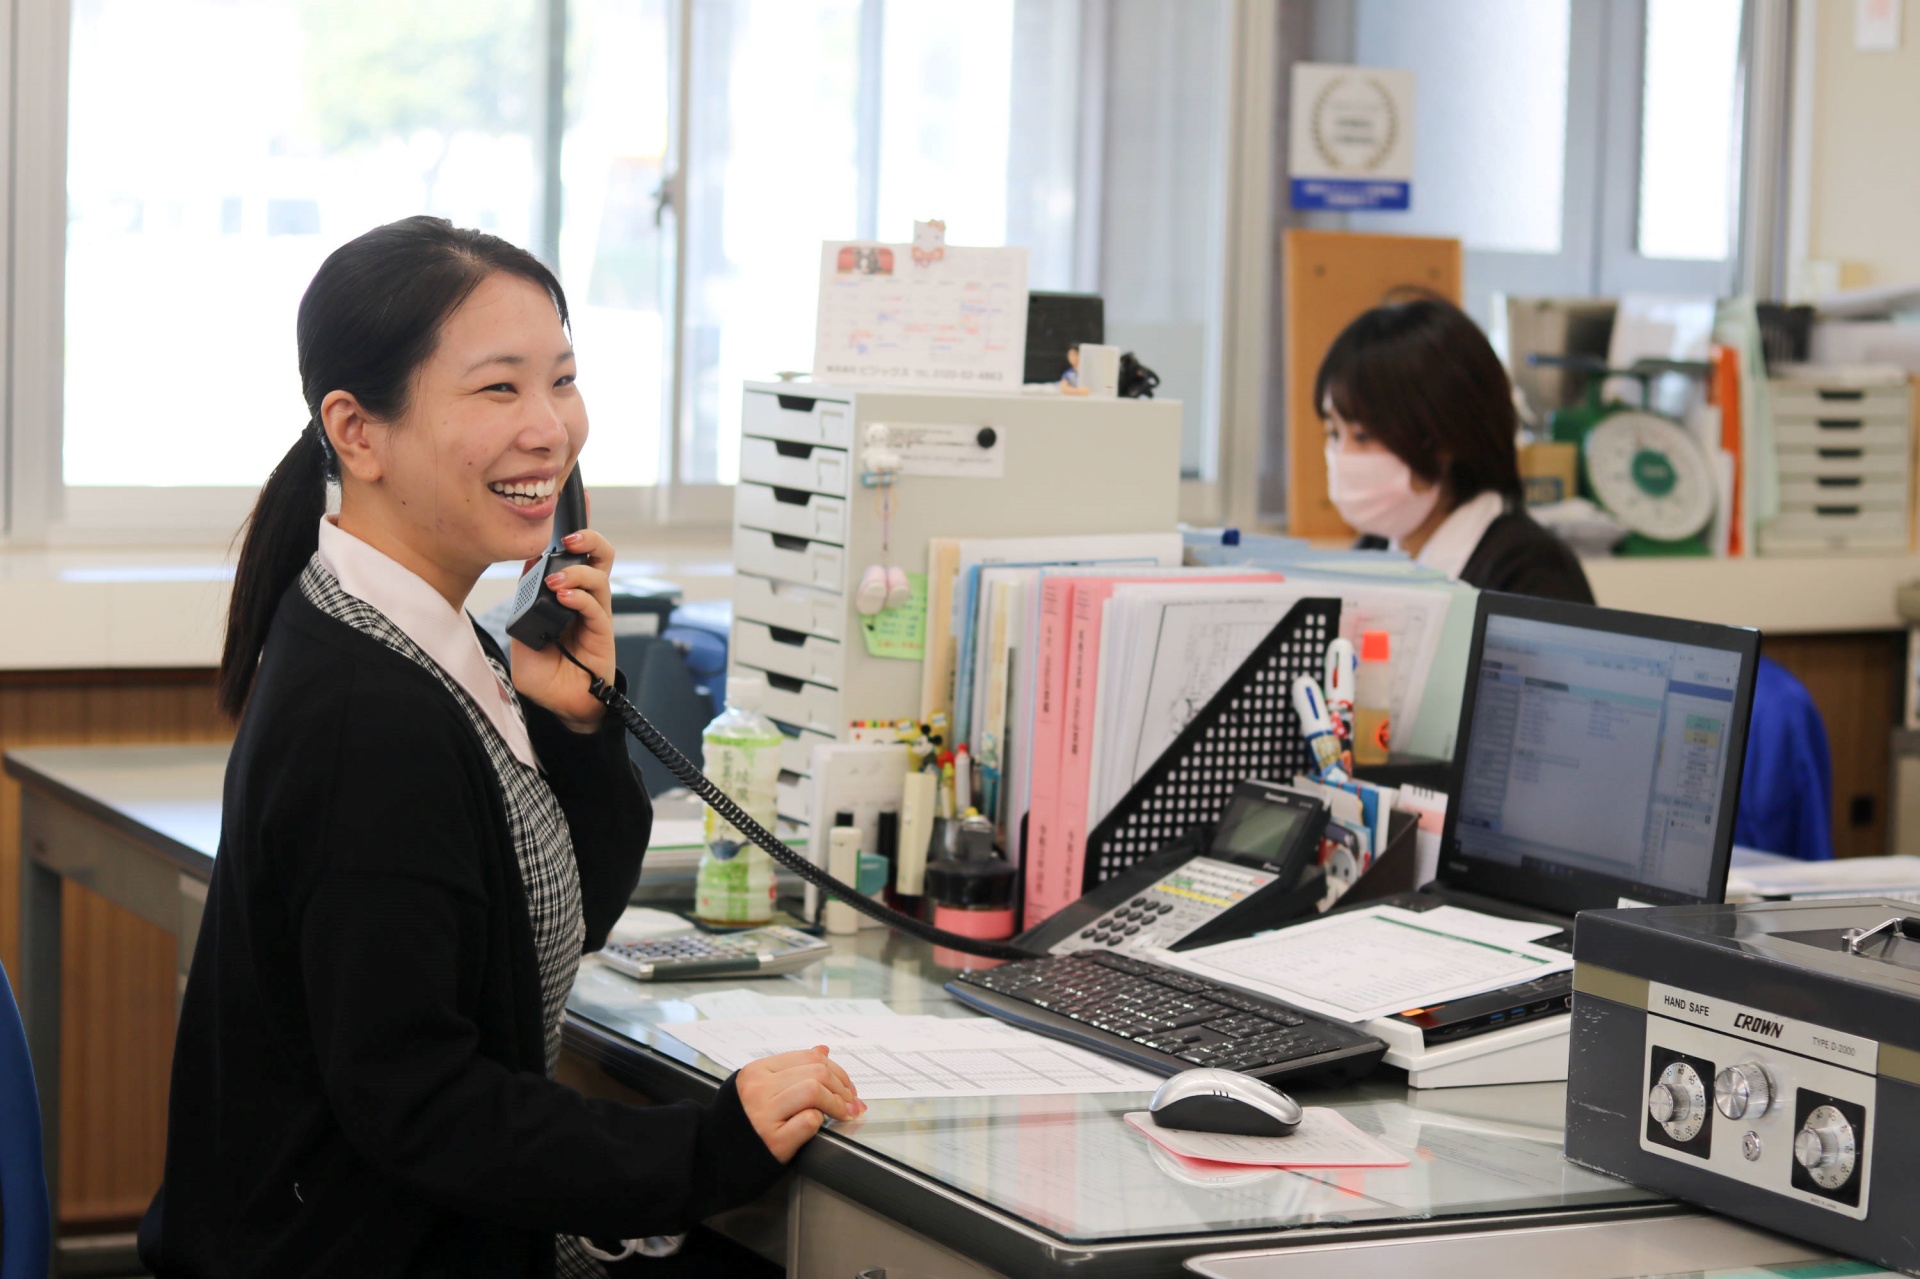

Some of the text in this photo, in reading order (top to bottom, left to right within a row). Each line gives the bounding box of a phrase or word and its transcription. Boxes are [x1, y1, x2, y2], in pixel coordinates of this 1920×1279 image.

[1664, 995, 1710, 1017] HAND SAFE
[1733, 1012, 1784, 1039] CROWN
[1812, 1036, 1856, 1057] TYPE D-2000
